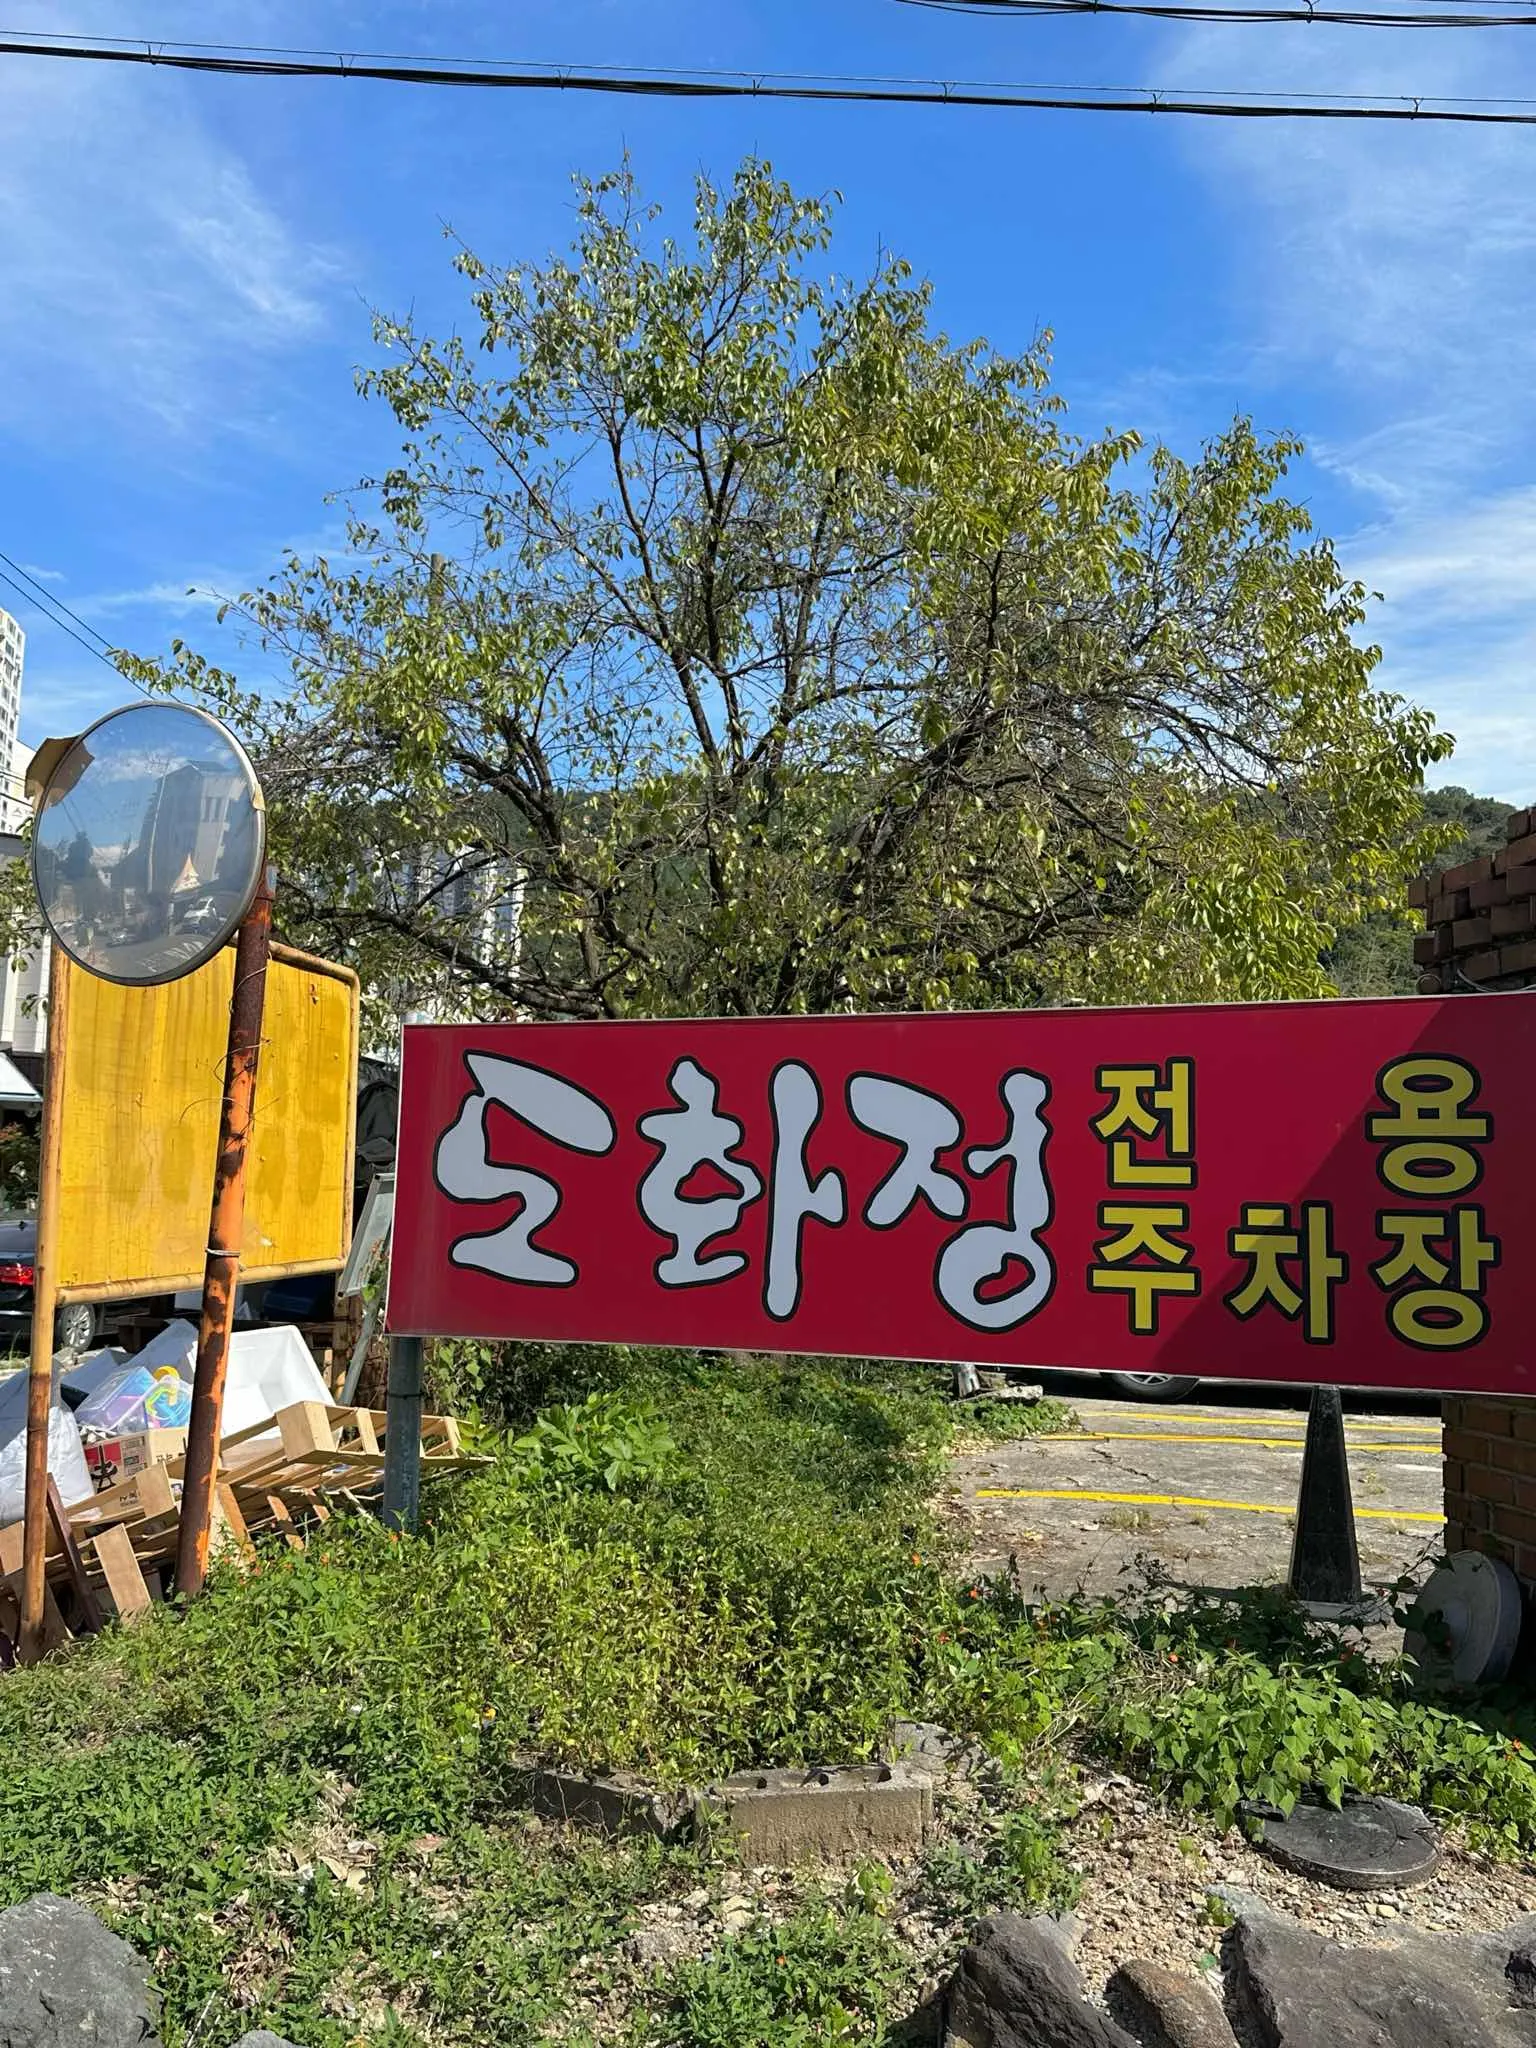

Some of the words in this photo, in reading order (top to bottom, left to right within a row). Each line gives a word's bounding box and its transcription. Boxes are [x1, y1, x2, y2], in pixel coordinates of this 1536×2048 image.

[435, 1049, 1055, 1333] 도화정
[1090, 1053, 1493, 1199] 전용
[1088, 1201, 1500, 1351] 주차장
